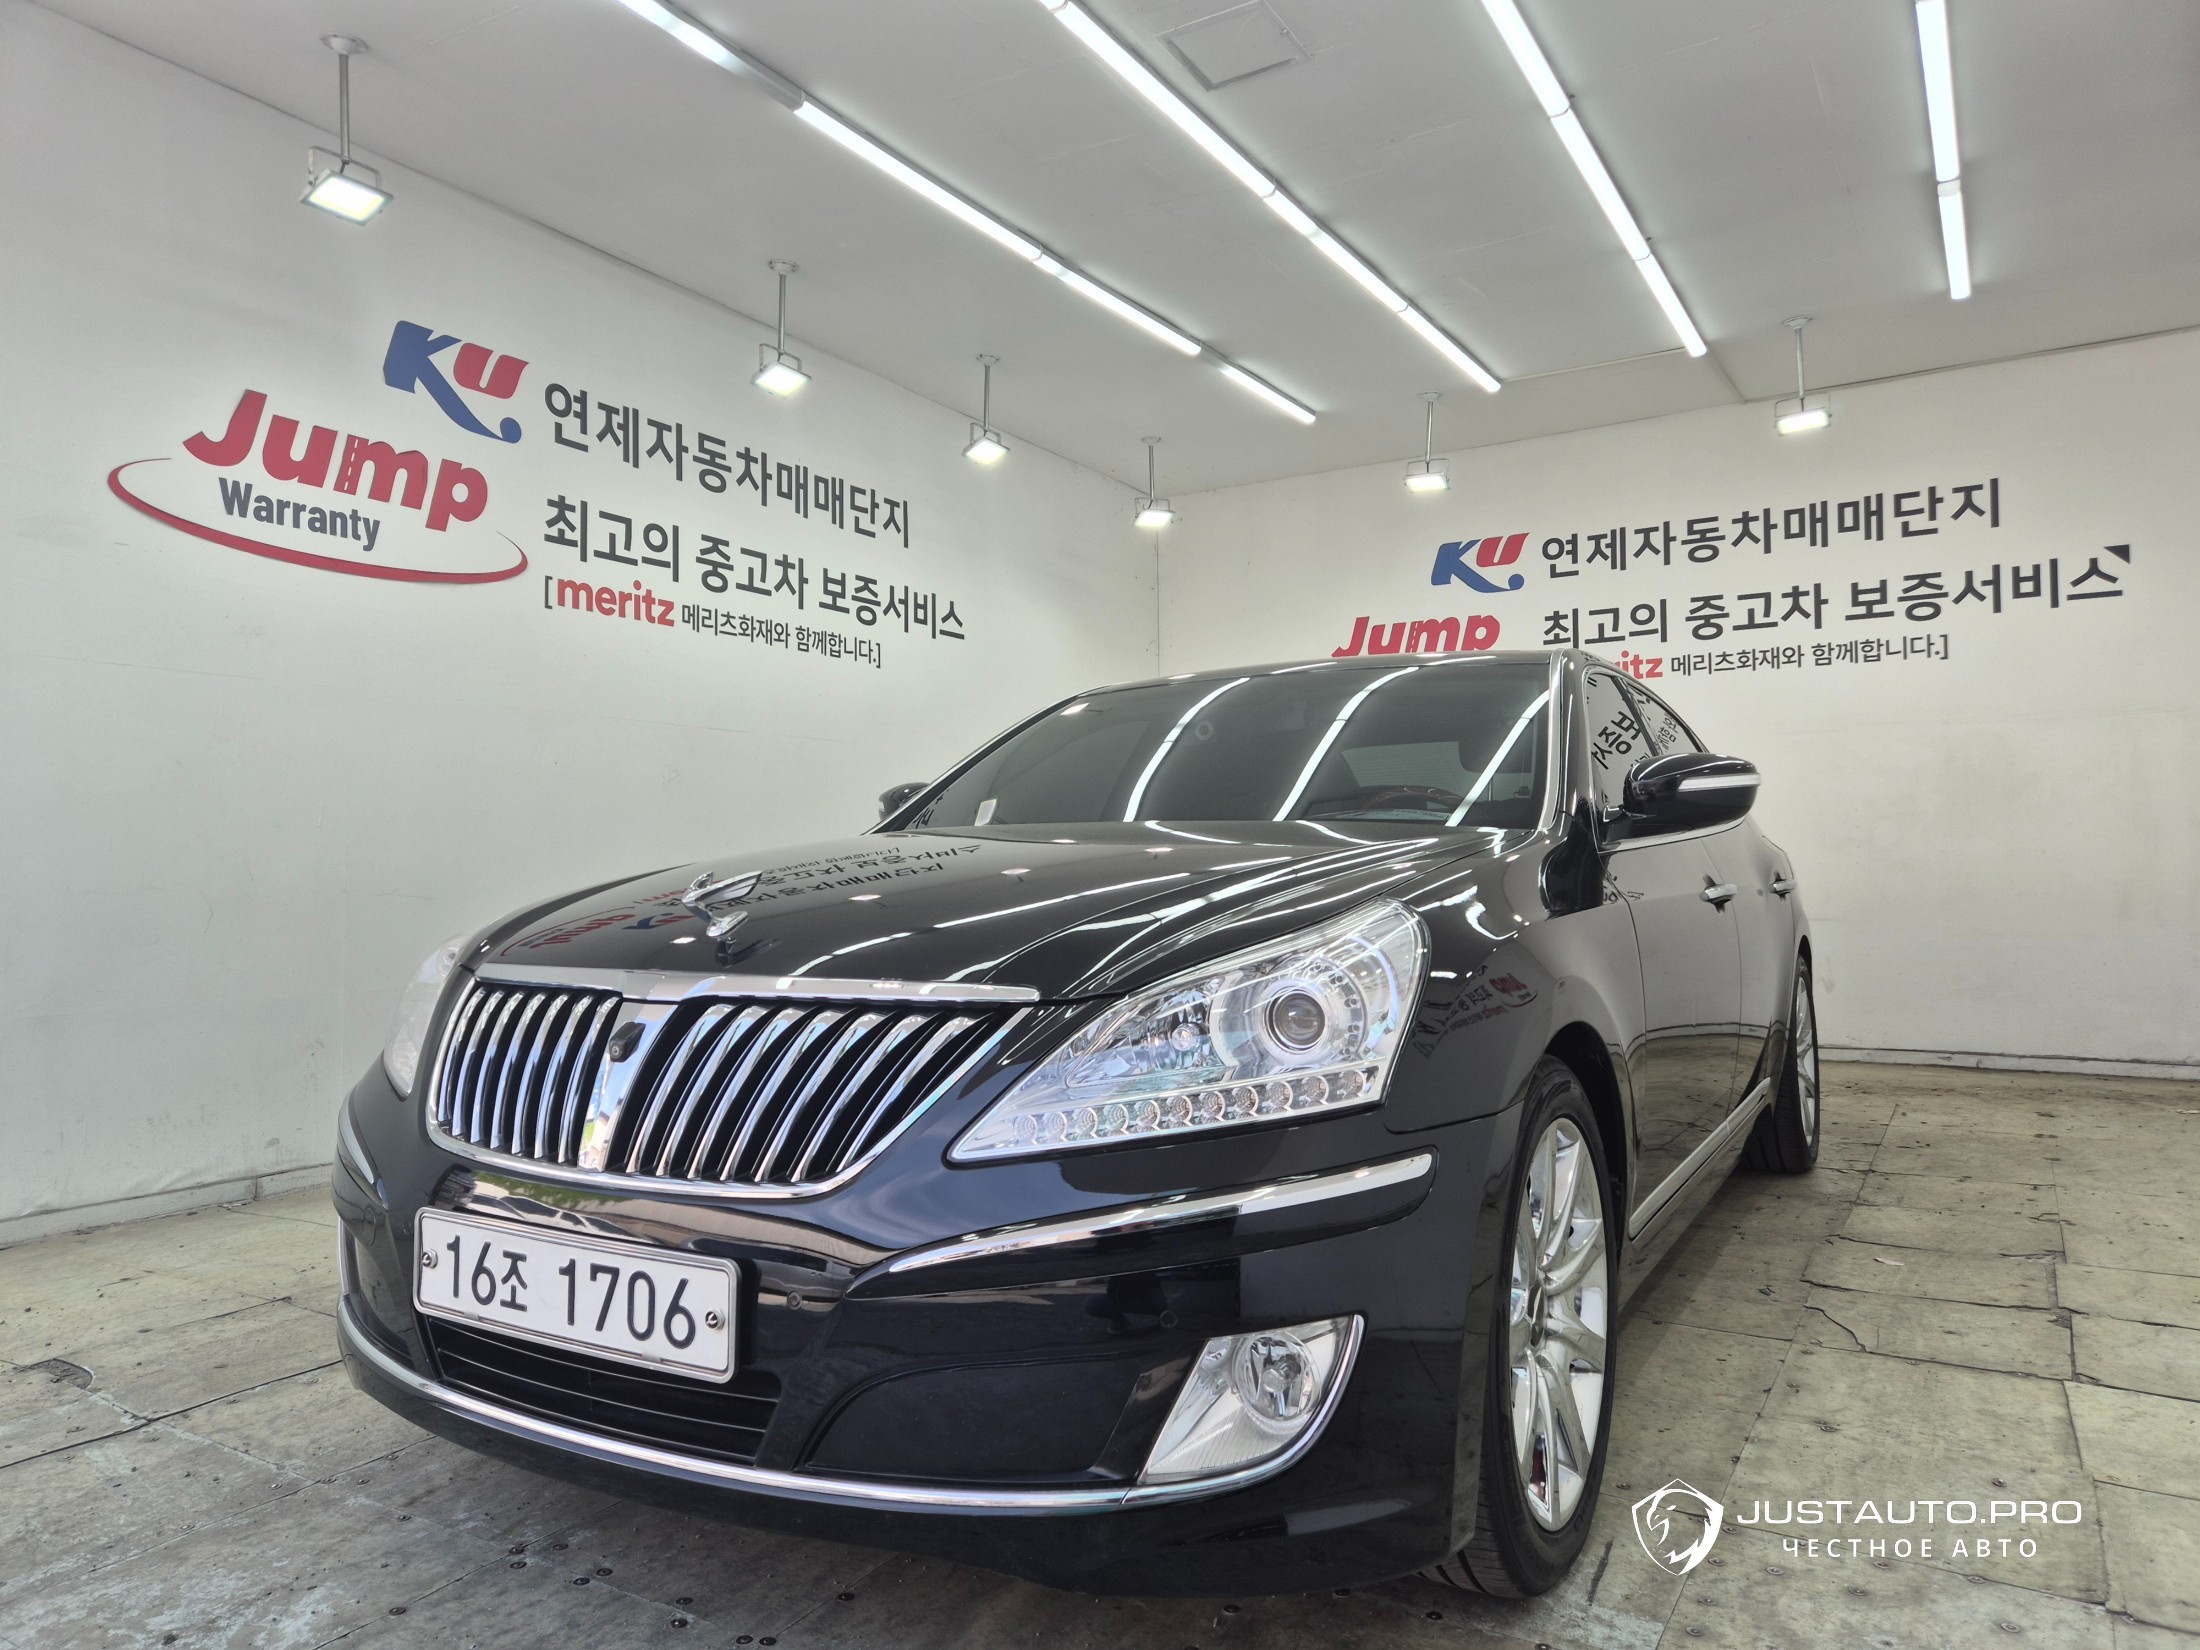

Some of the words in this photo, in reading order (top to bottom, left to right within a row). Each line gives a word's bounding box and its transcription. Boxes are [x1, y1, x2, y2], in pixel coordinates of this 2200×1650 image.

[182, 389, 488, 532] Jump
[544, 383, 910, 549] 연제자동차매매단지
[218, 477, 381, 551] Warranty
[1542, 477, 2000, 579] 연제자동차매매단지
[544, 494, 680, 583] 최고의
[695, 533, 809, 610] 중고차
[818, 567, 966, 641] 보증서비스
[1543, 598, 1668, 649] 최고의
[1685, 582, 1829, 641] 중고차
[1845, 557, 2124, 622] 보증서비스
[681, 603, 790, 650] 메리츠화재와
[1331, 614, 1501, 657] Jump
[1615, 650, 1663, 679] itz
[1671, 644, 1805, 676] 메리츠화재와
[447, 1235, 528, 1312] 16조
[558, 1258, 696, 1349] 1706
